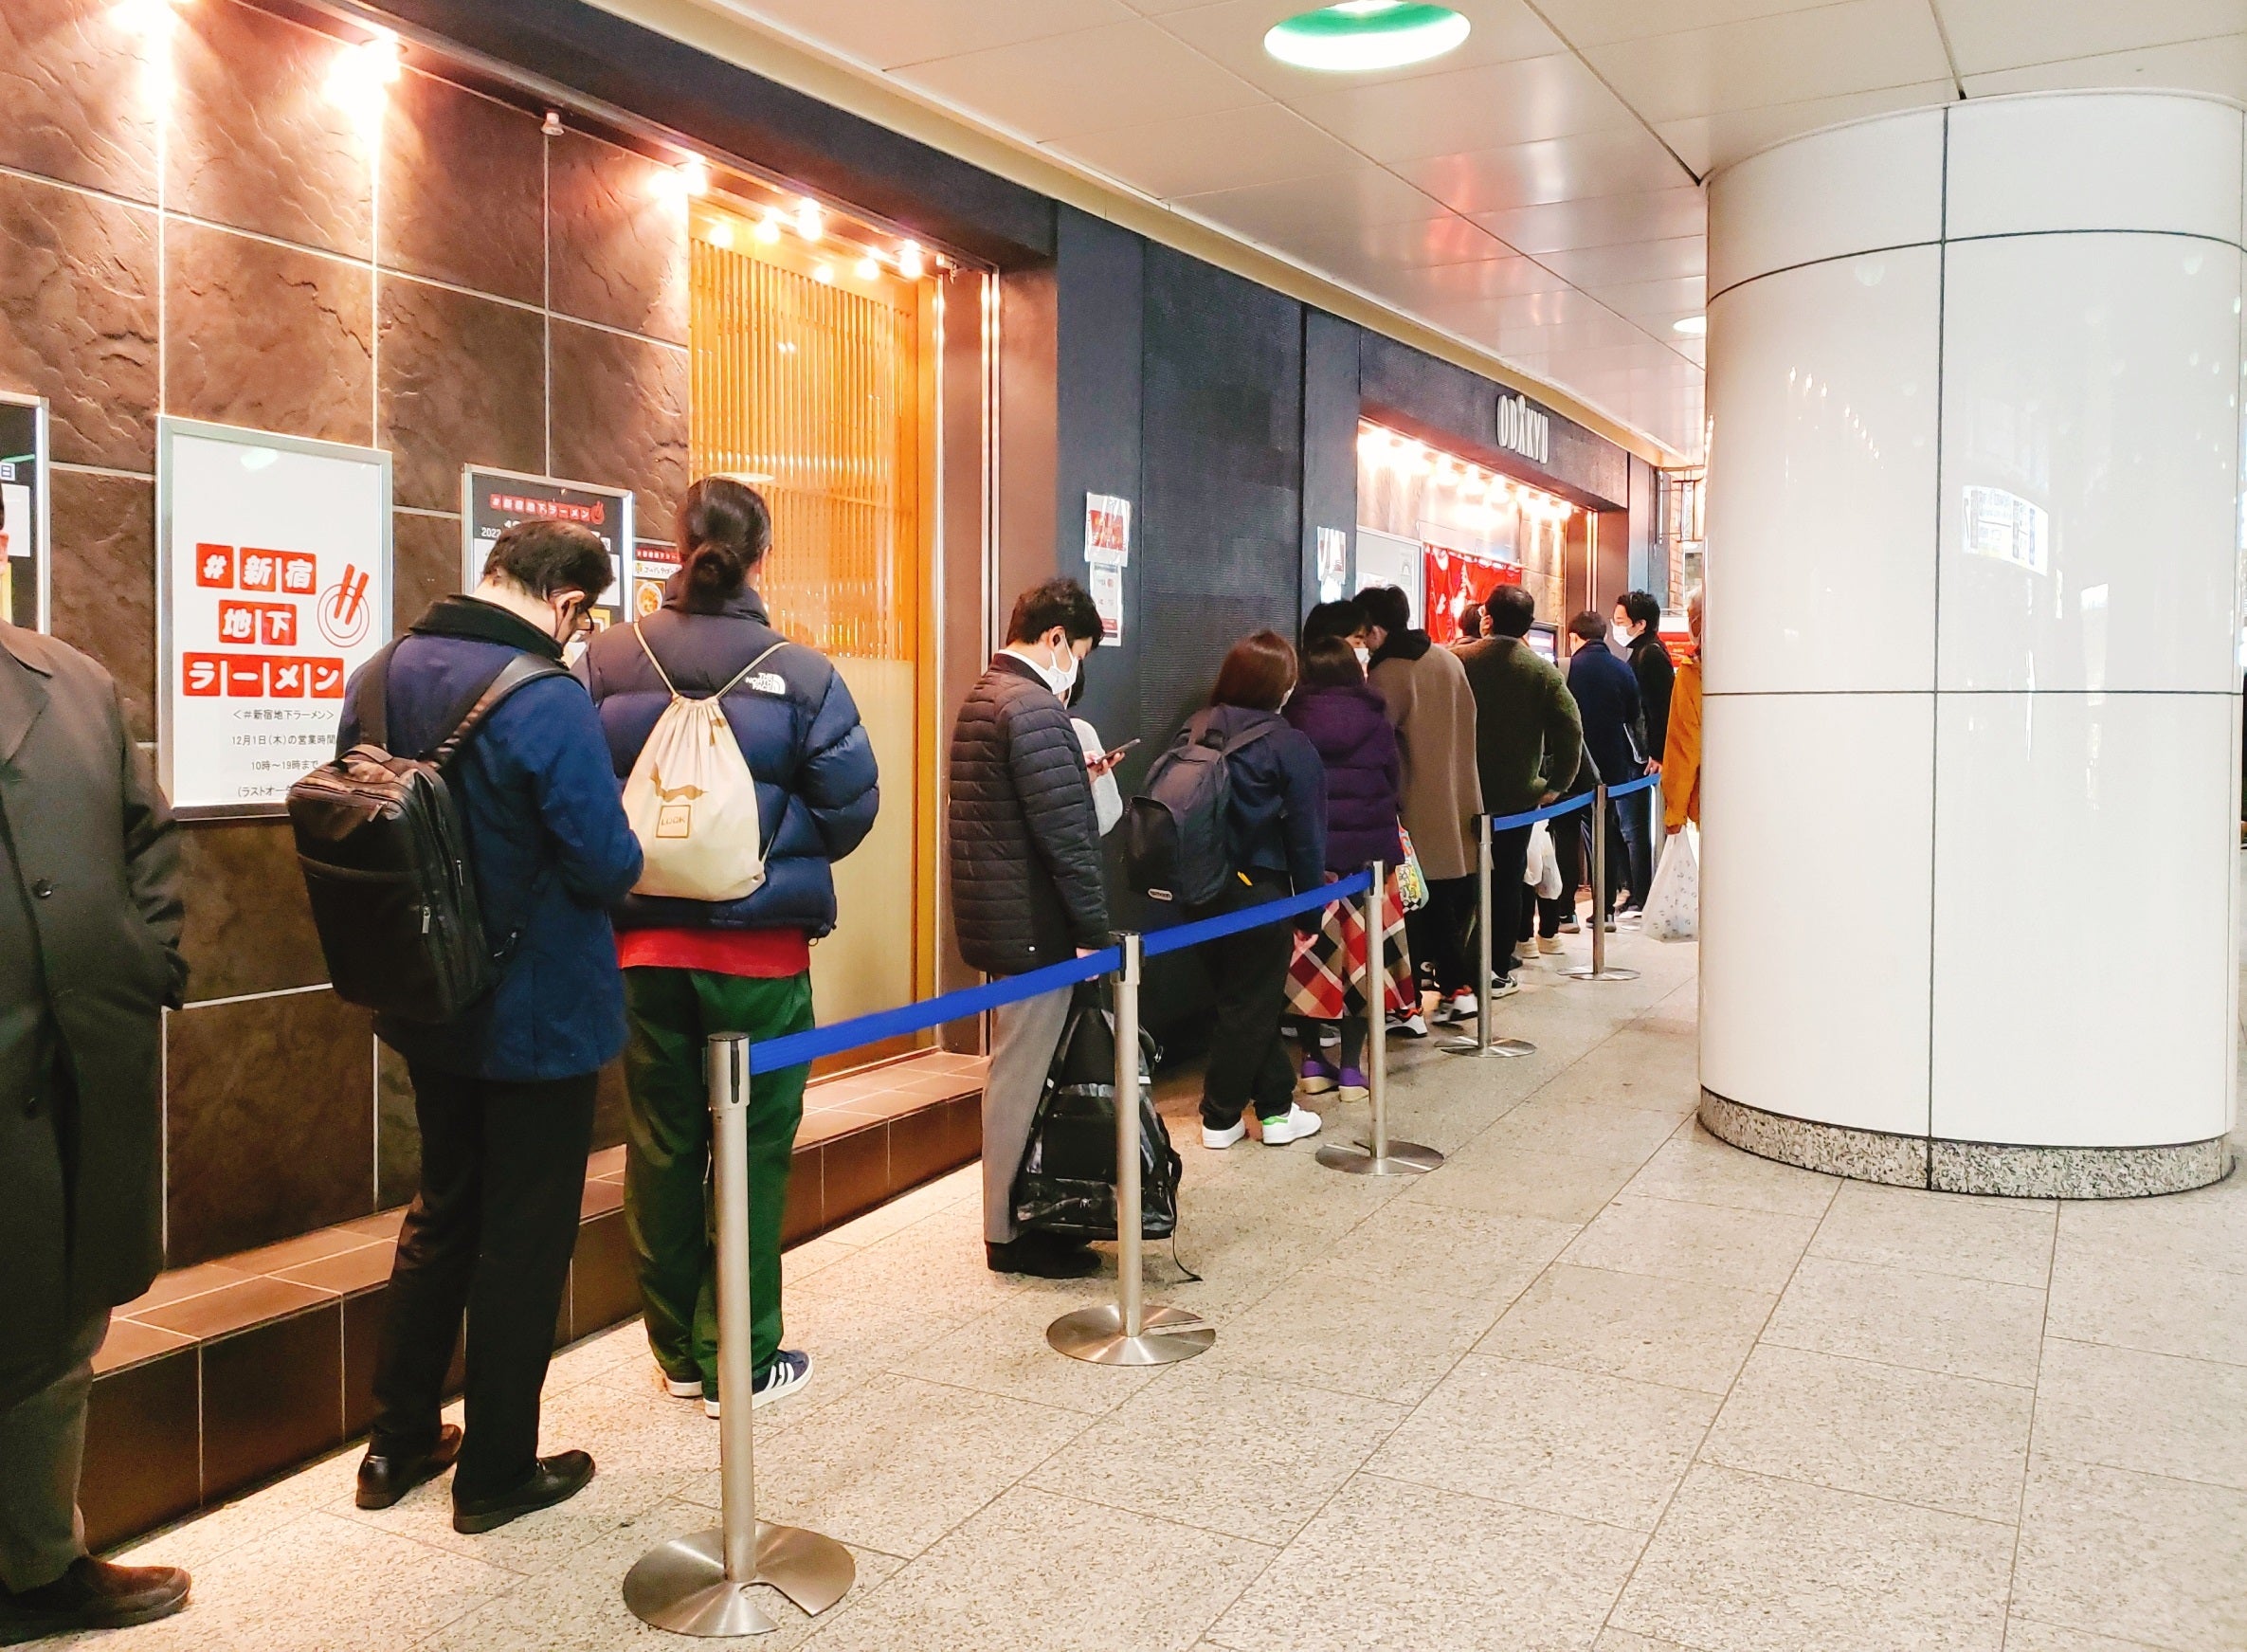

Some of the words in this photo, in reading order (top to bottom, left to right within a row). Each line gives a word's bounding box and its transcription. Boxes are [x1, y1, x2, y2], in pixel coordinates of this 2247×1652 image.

[202, 553, 314, 590] #新宿
[222, 608, 293, 640] 地下
[188, 661, 340, 692] ラーメン
